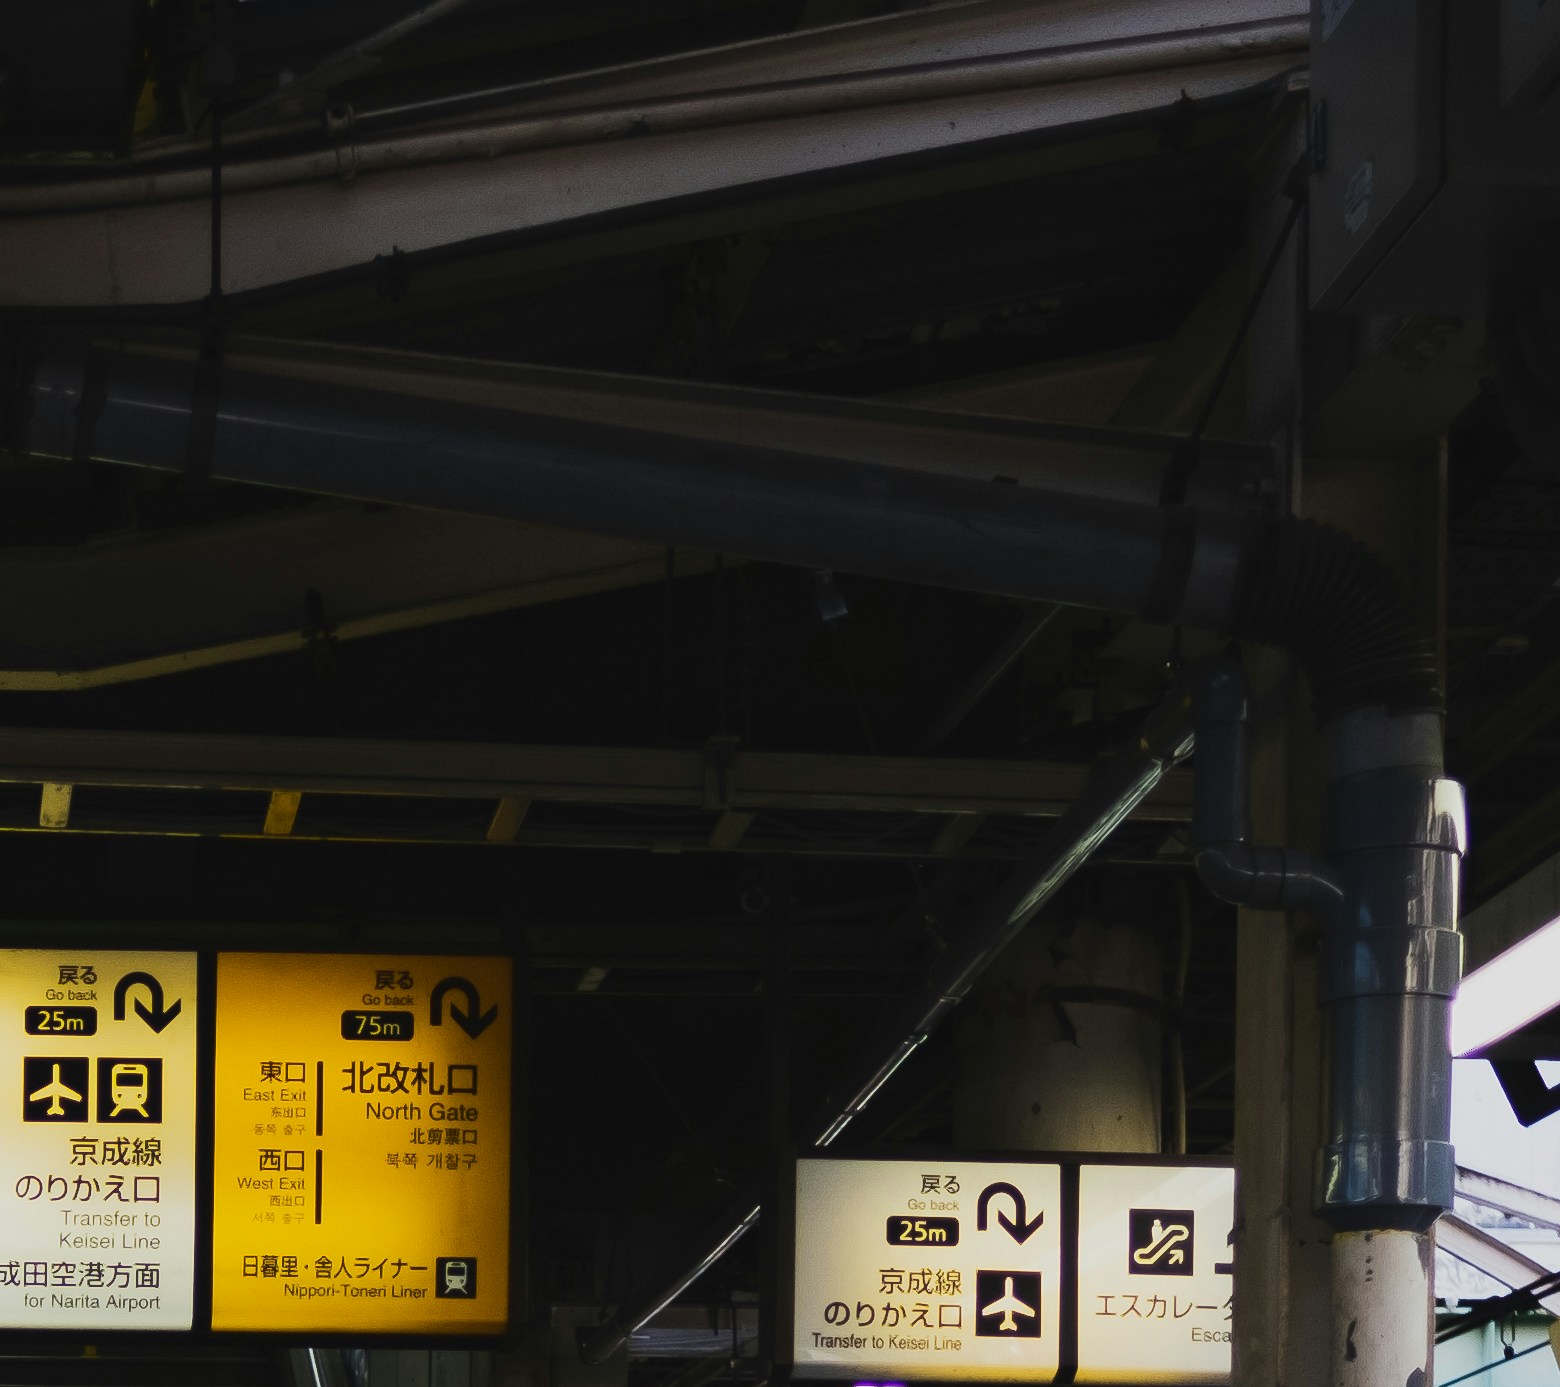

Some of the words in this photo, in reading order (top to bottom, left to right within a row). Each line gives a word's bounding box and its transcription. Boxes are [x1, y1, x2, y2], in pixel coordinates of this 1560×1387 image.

[58, 965, 97, 985] 戻る
[374, 970, 414, 990] 戻る
[45, 989, 64, 1002] Go
[67, 989, 97, 1002] back
[362, 994, 381, 1007] Go
[383, 994, 414, 1007] back
[37, 1010, 84, 1031] 25m
[355, 1015, 401, 1036] 75m
[260, 1061, 306, 1083] 東口
[341, 1061, 478, 1095] 北改札口
[243, 1088, 275, 1101] East
[280, 1088, 306, 1101] Exit
[366, 1102, 421, 1120] North
[429, 1102, 478, 1121] Gate
[69, 1136, 163, 1167] 京成線
[259, 1149, 305, 1171] 西口
[15, 1174, 161, 1203] のりかえ口
[237, 1177, 274, 1190] West
[279, 1177, 305, 1190] Exit
[920, 1174, 960, 1194] 戻る
[908, 1198, 926, 1212] Go
[930, 1198, 960, 1212] back
[60, 1210, 138, 1228] Transfer
[144, 1211, 161, 1228] to
[59, 1232, 116, 1250] Keisei
[122, 1233, 161, 1250] Line
[899, 1220, 947, 1243] 25m
[242, 1255, 428, 1279] 日暮里・舎人ライナー
[284, 1284, 387, 1300] Nippori-Toneri
[391, 1284, 428, 1299] Liner
[879, 1268, 962, 1296] 京成線
[24, 1293, 45, 1309] for
[51, 1293, 100, 1309] Narita
[105, 1294, 161, 1312] Airport
[824, 1302, 962, 1329] のりかえ口
[811, 1332, 867, 1349] Transfer
[871, 1333, 884, 1349] to
[888, 1334, 929, 1350] Keisei
[933, 1335, 962, 1351] Line
